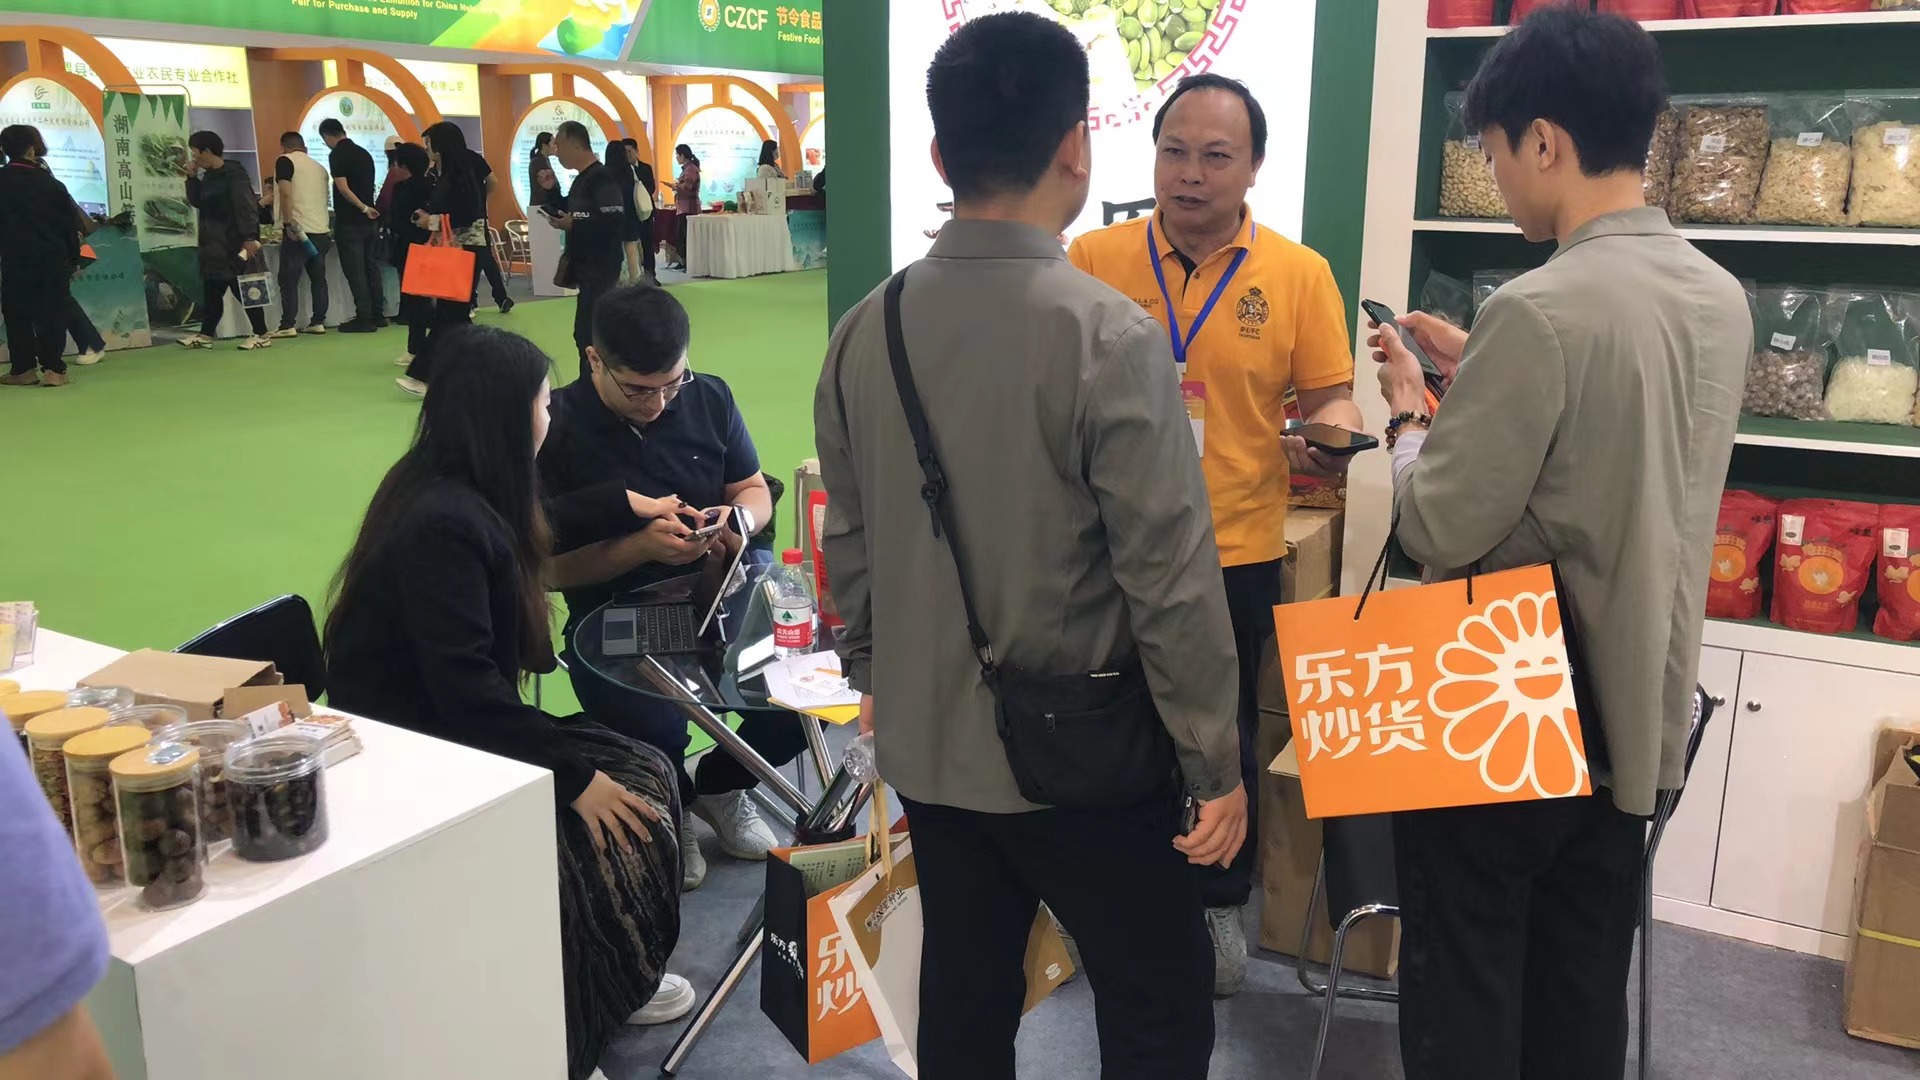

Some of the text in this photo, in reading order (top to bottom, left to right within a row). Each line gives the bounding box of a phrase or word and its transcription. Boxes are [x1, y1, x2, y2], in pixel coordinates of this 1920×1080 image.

[313, 0, 325, 8] for
[328, 1, 369, 13] Purchase
[372, 7, 388, 15] and
[390, 7, 418, 19] Supply
[422, 0, 433, 8] for
[436, 2, 458, 11] China
[724, 5, 768, 31] CZCF
[776, 6, 822, 30] 节令食品
[777, 31, 820, 45] Festive Food
[1295, 643, 1414, 704] 乐方
[1300, 699, 1428, 762] 炒货
[816, 971, 863, 1022] 炒
